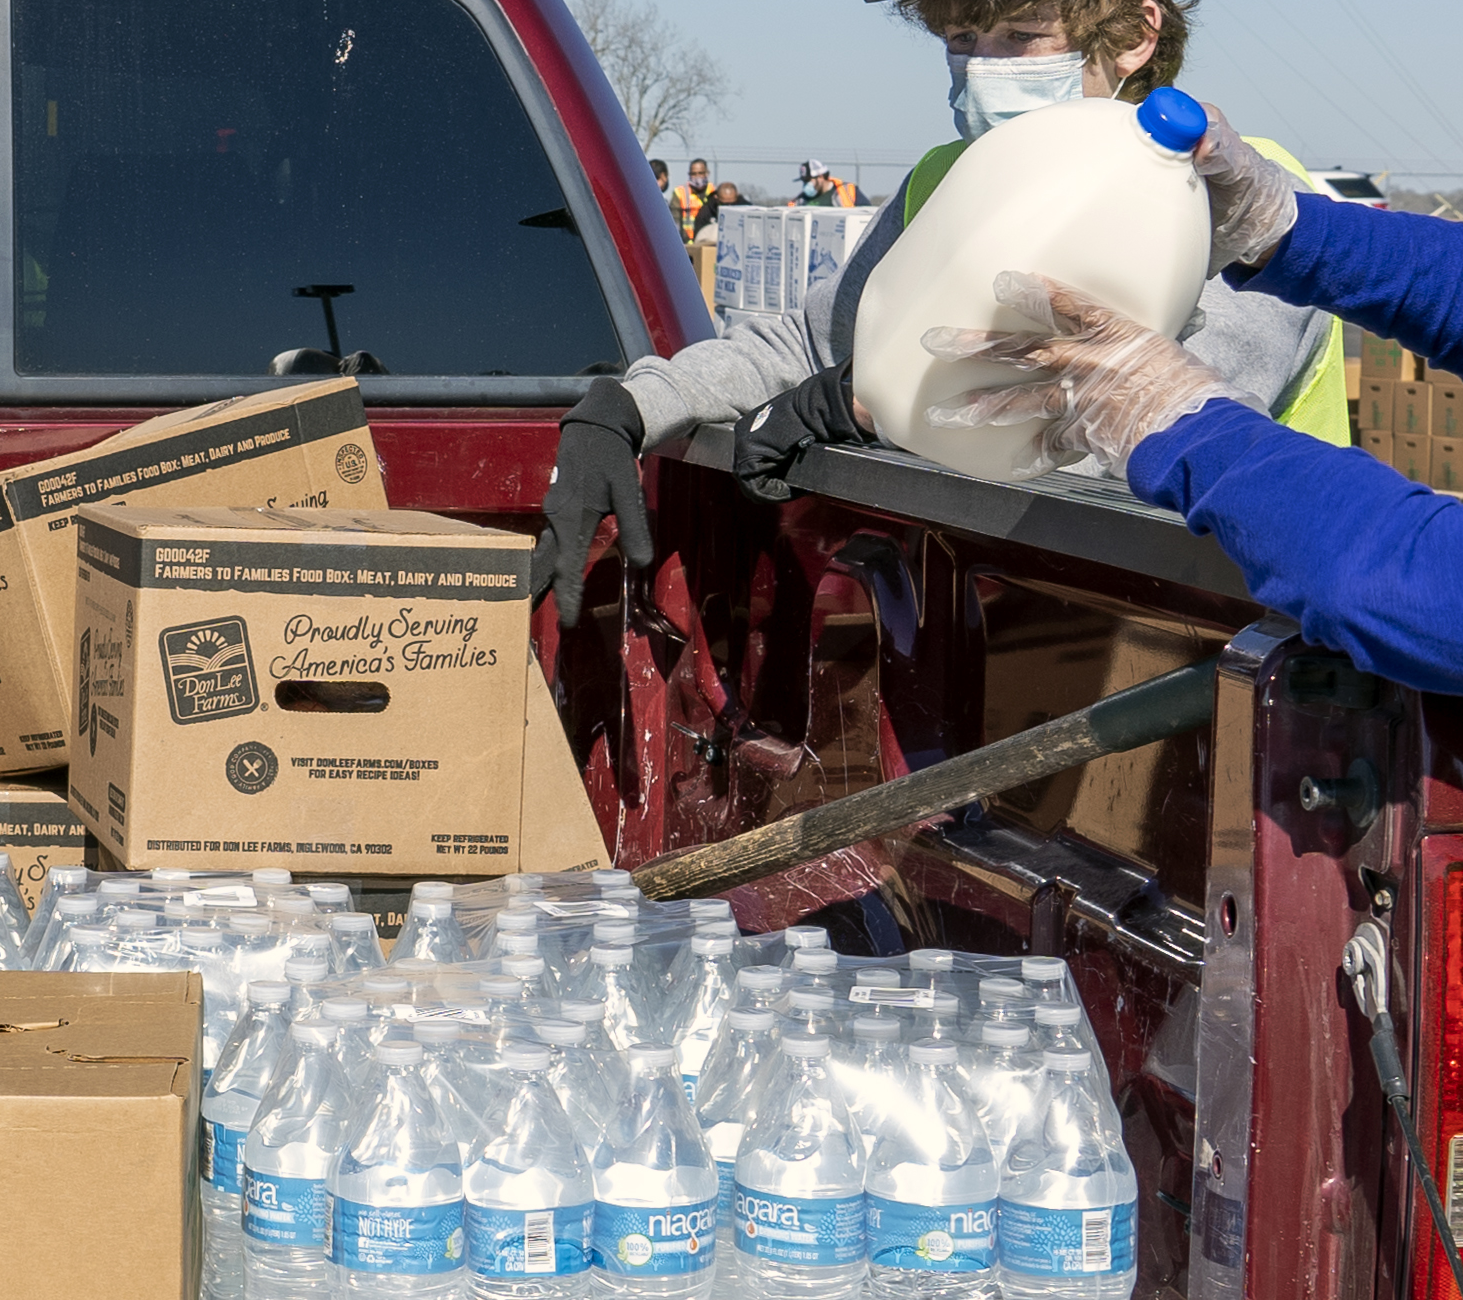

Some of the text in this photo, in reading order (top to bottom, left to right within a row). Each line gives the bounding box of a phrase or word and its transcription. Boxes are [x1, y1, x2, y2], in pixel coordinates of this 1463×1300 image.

[41, 427, 292, 508] FARMERS TO FAMILIES FOOD BOX: MEAT, DAIRY AND PRODUCE
[47, 515, 69, 532] KEEP
[155, 564, 517, 588] FARMERS TO FAMILIES FOOD BOX: MEAT, DAIRY AND PRODUCE
[283, 607, 479, 649] Proudly Serving
[269, 639, 498, 680] America's Families
[177, 672, 243, 698] Don Lee
[192, 693, 246, 714] Farms
[291, 757, 439, 771] VISIT DONLEEFARMS.COM/BOXES
[308, 769, 420, 781] FOR EASY RECIPE IDEAS!
[33, 823, 66, 836] DAIRY
[69, 825, 86, 836] AN
[431, 834, 509, 844] KEEP REFRIGERATED
[147, 839, 393, 856] DISTRIBUTED FOR DON LEE FARMS, INGLEWOOD, CA 90302
[436, 845, 509, 855] NET WT 22 POUNDS
[382, 1218, 414, 1239] HYPE
